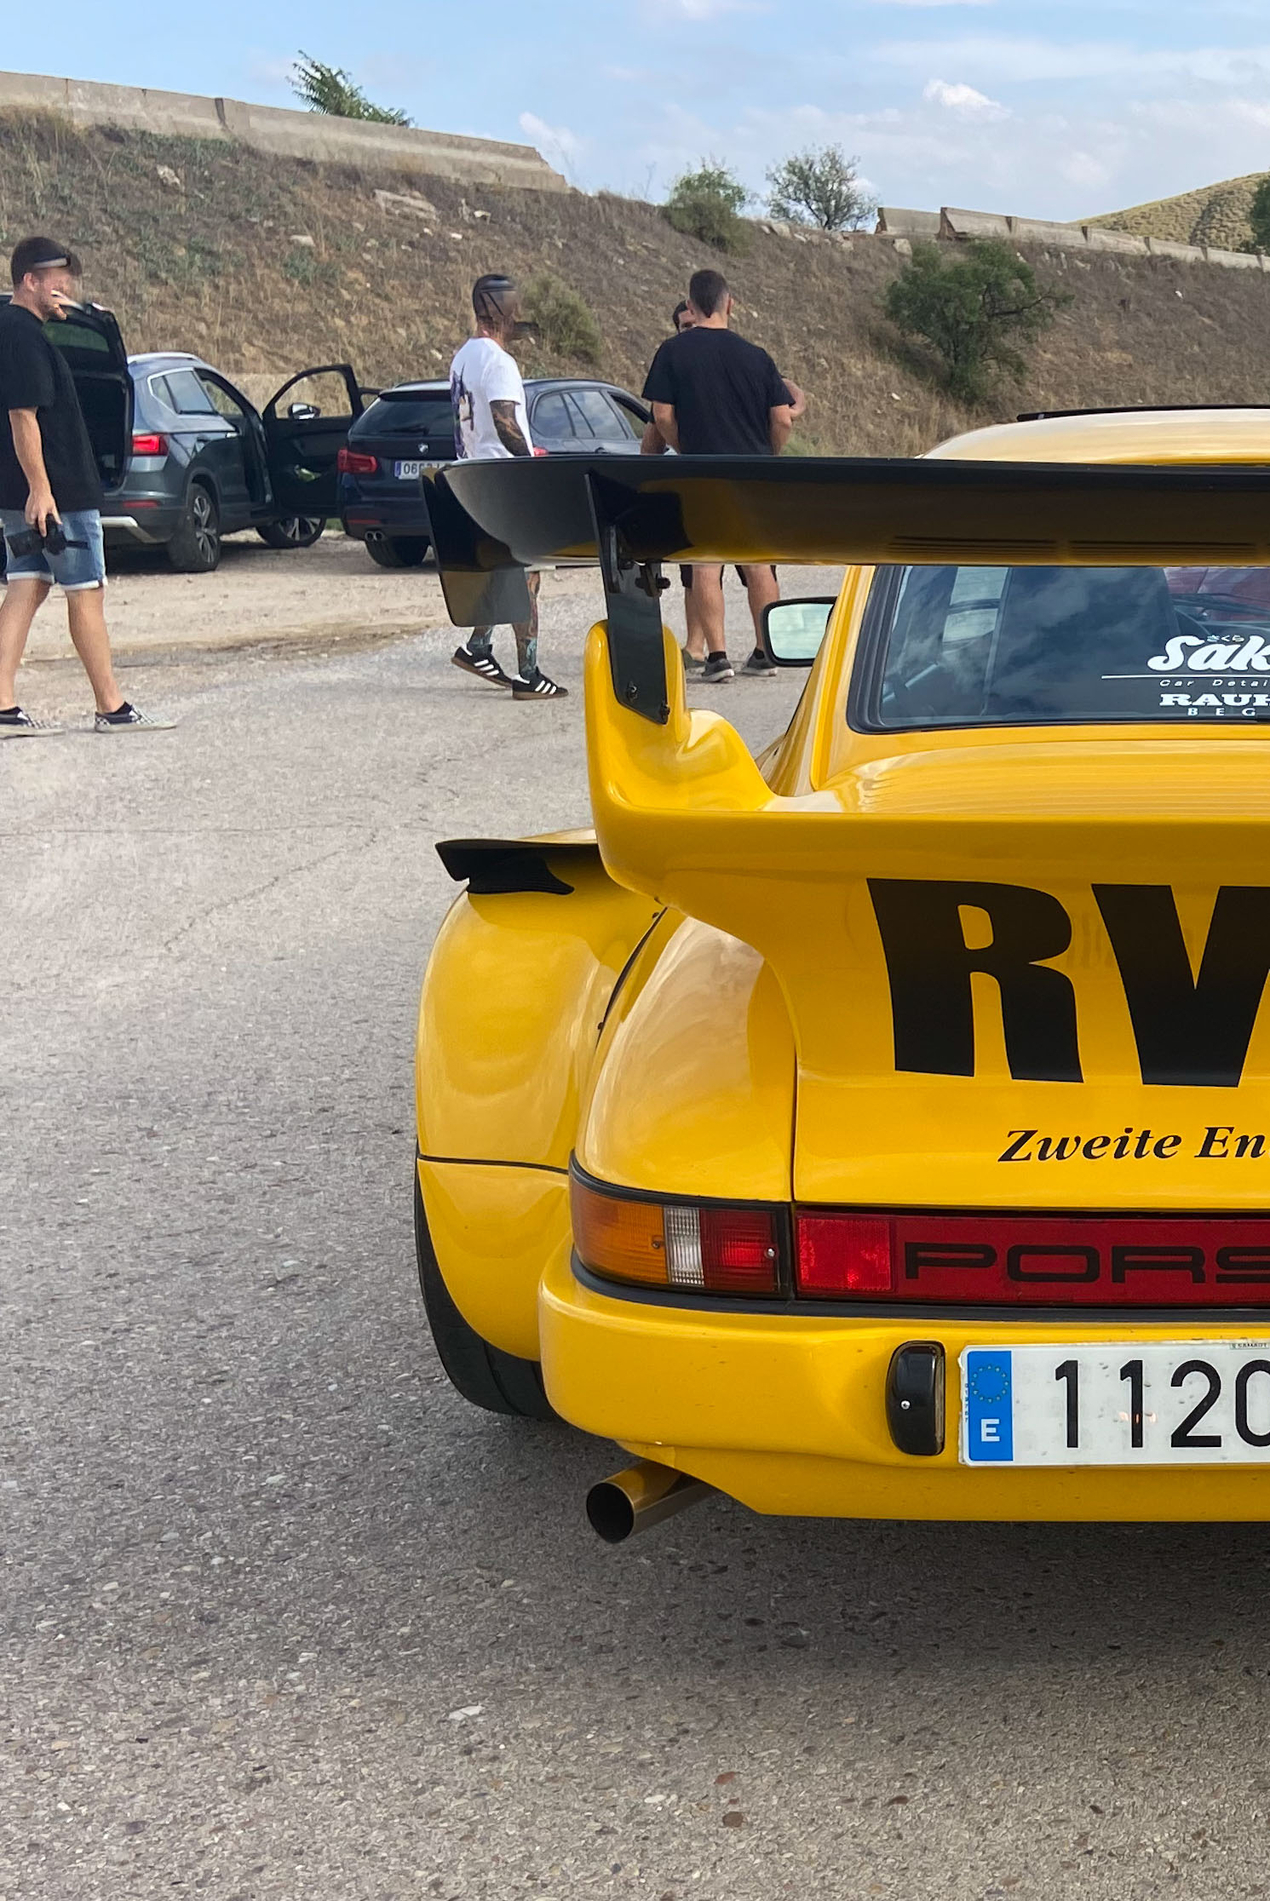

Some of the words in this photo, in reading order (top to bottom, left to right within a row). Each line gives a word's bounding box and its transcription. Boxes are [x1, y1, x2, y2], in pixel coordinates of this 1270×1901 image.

[1159, 679, 1194, 687] Car
[998, 1127, 1183, 1163] Zweite
[981, 1418, 1000, 1442] E
